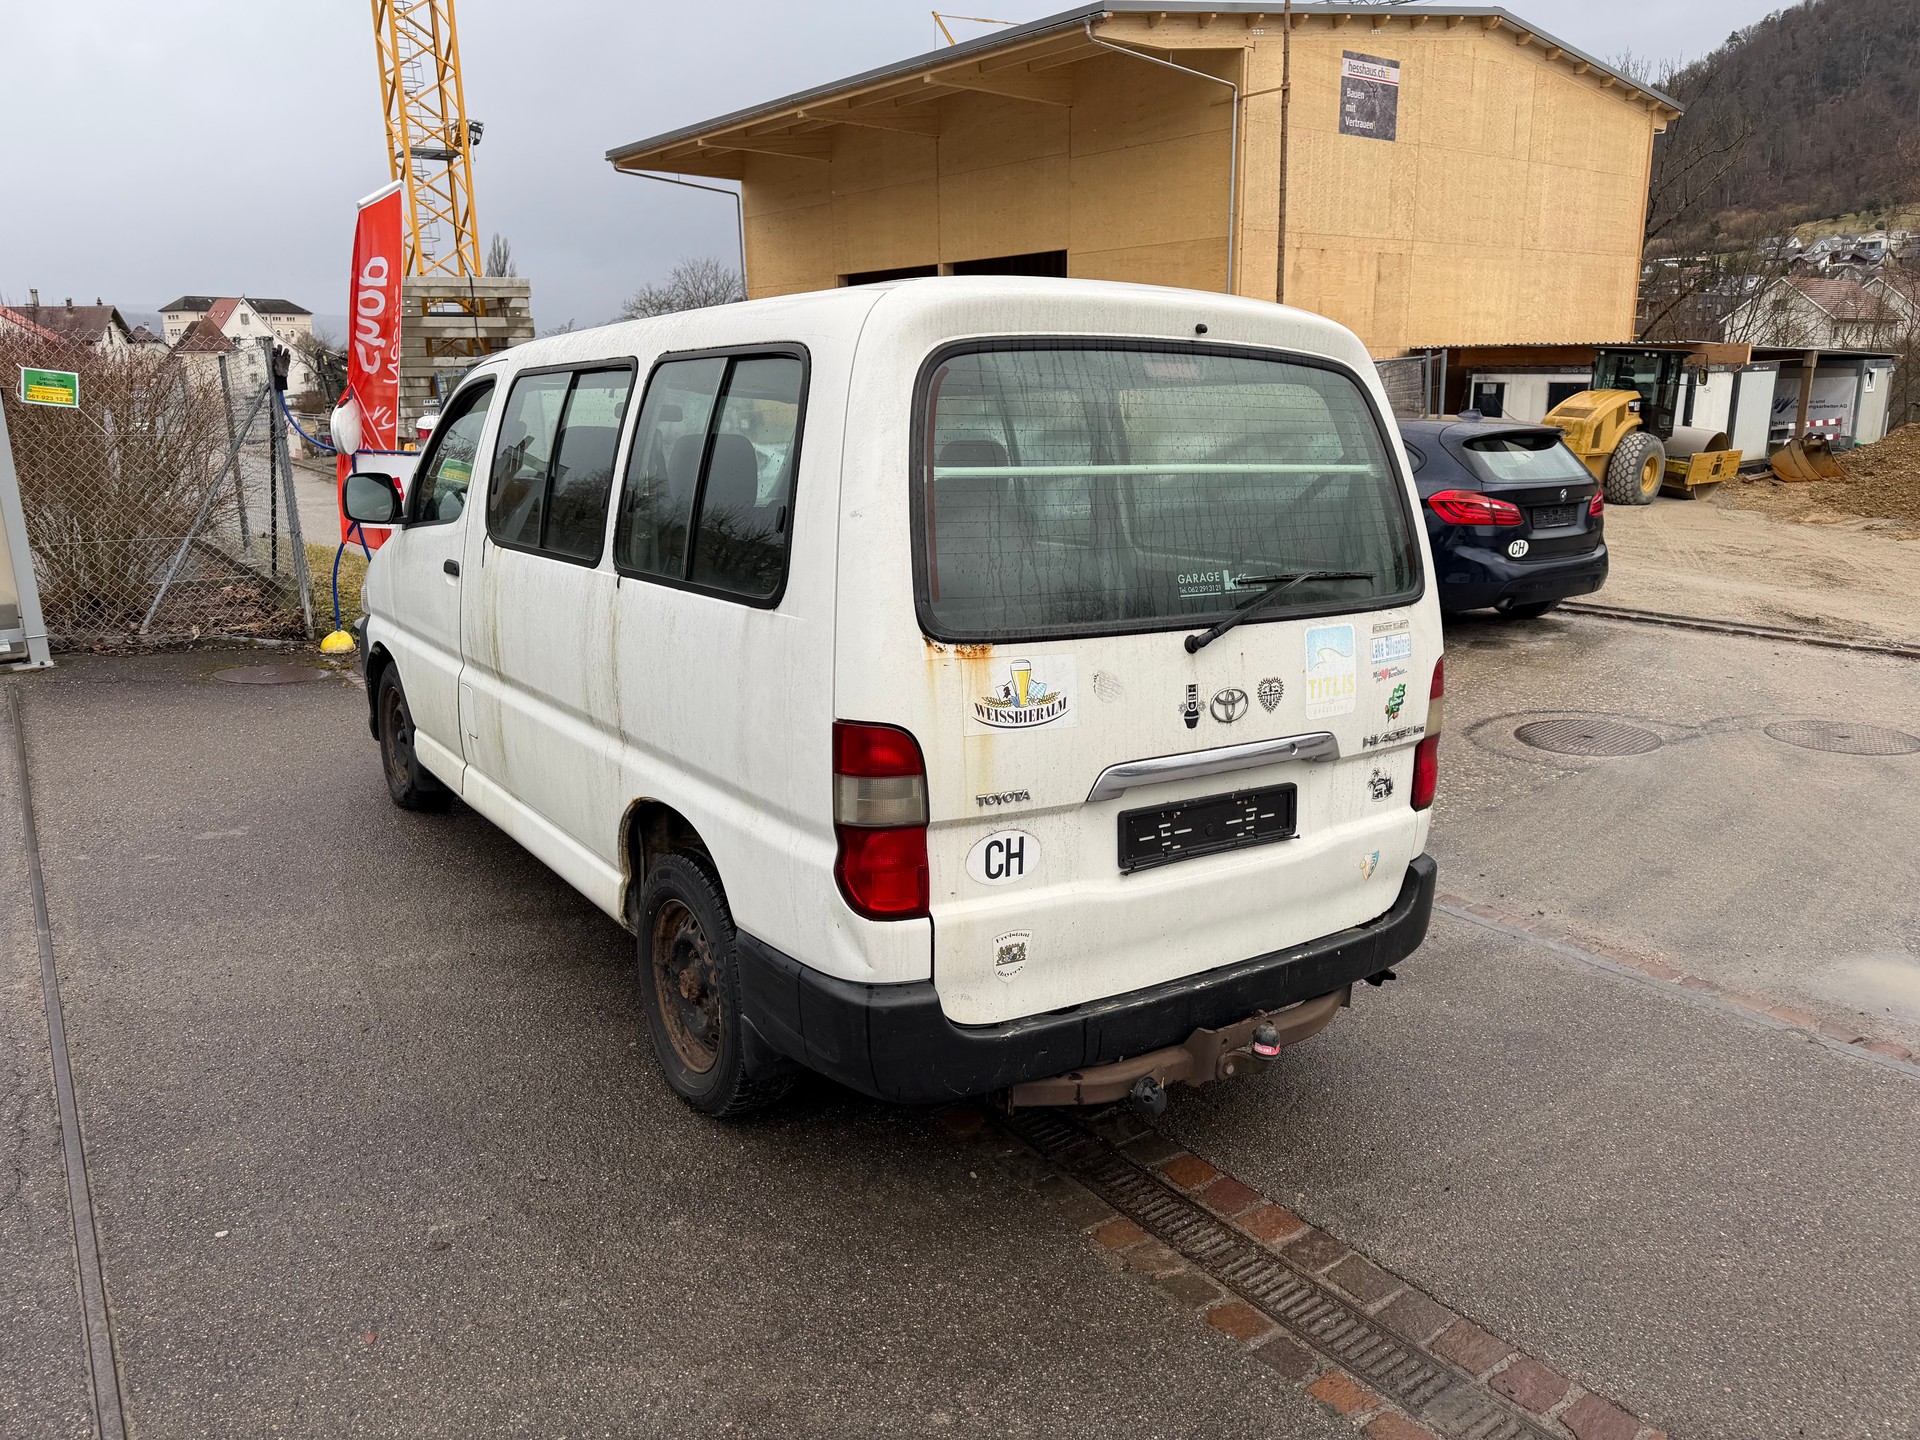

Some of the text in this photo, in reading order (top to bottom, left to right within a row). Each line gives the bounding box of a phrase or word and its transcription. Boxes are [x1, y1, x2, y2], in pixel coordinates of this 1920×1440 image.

[1348, 61, 1386, 78] hesshaus.ch
[1346, 88, 1364, 100] Bauen
[1345, 102, 1356, 112] mit
[1511, 541, 1526, 555] CH
[1178, 572, 1220, 584] GARAGE
[1308, 674, 1355, 700] TITLIS
[974, 696, 1067, 724] WEISSBIERALM
[1362, 727, 1407, 748] HIACE
[976, 789, 1031, 807] TOYOTA
[985, 836, 1025, 880] CH
